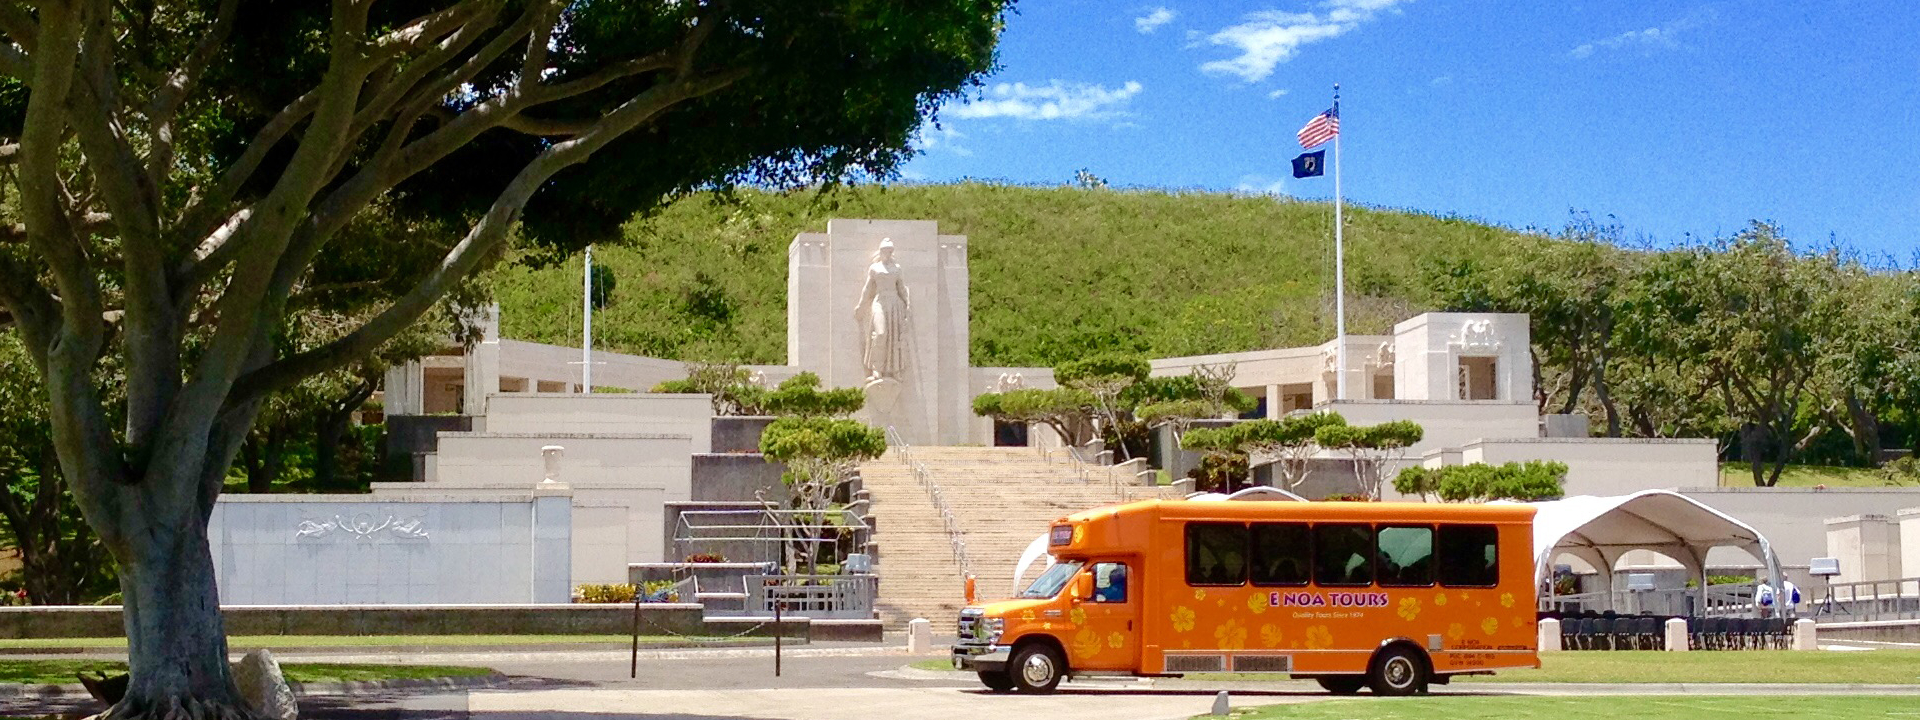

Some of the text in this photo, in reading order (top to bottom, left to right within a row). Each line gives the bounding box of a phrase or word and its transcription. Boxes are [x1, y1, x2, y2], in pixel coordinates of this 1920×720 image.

[1270, 592, 1388, 607] E NOA TOURS
[1293, 611, 1314, 619] Quality
